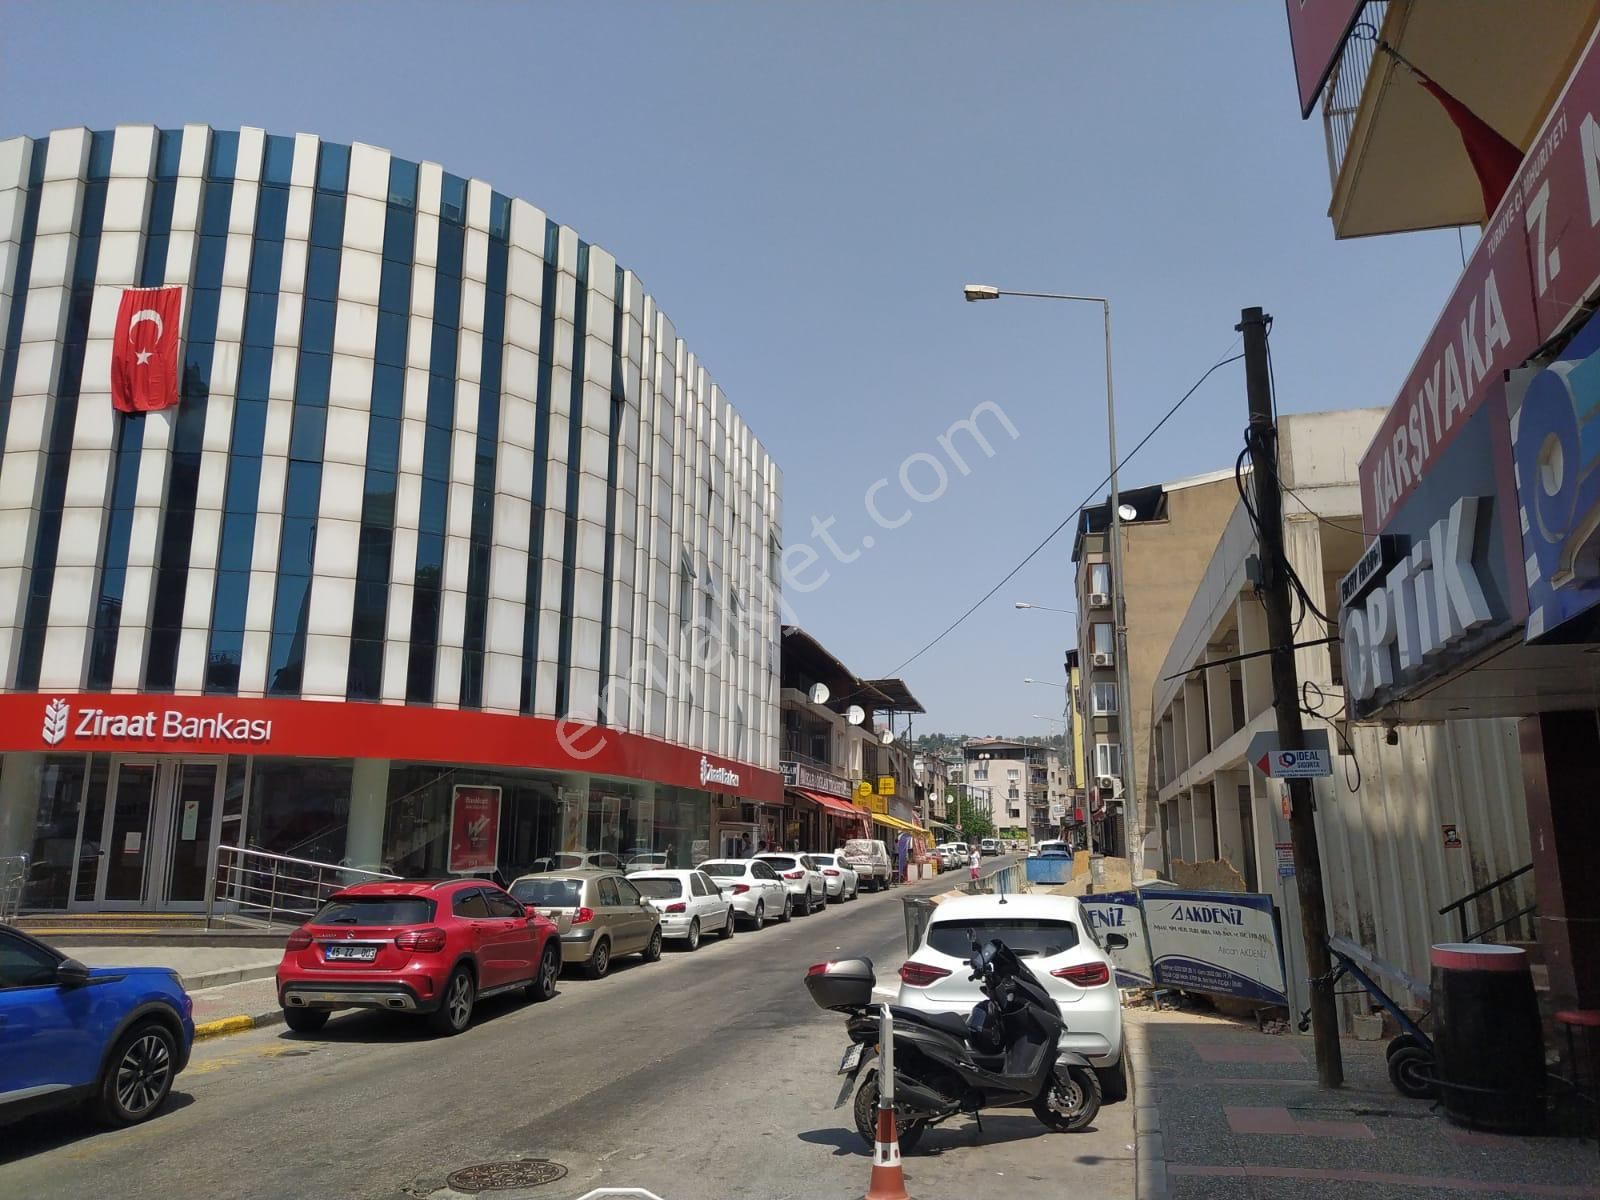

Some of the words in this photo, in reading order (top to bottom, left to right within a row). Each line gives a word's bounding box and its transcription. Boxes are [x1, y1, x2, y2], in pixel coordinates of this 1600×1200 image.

[1373, 268, 1511, 530] KARŞIYAKA
[1525, 179, 1560, 297] 7.
[75, 708, 157, 738] Ziraat
[162, 710, 273, 741] Bankası
